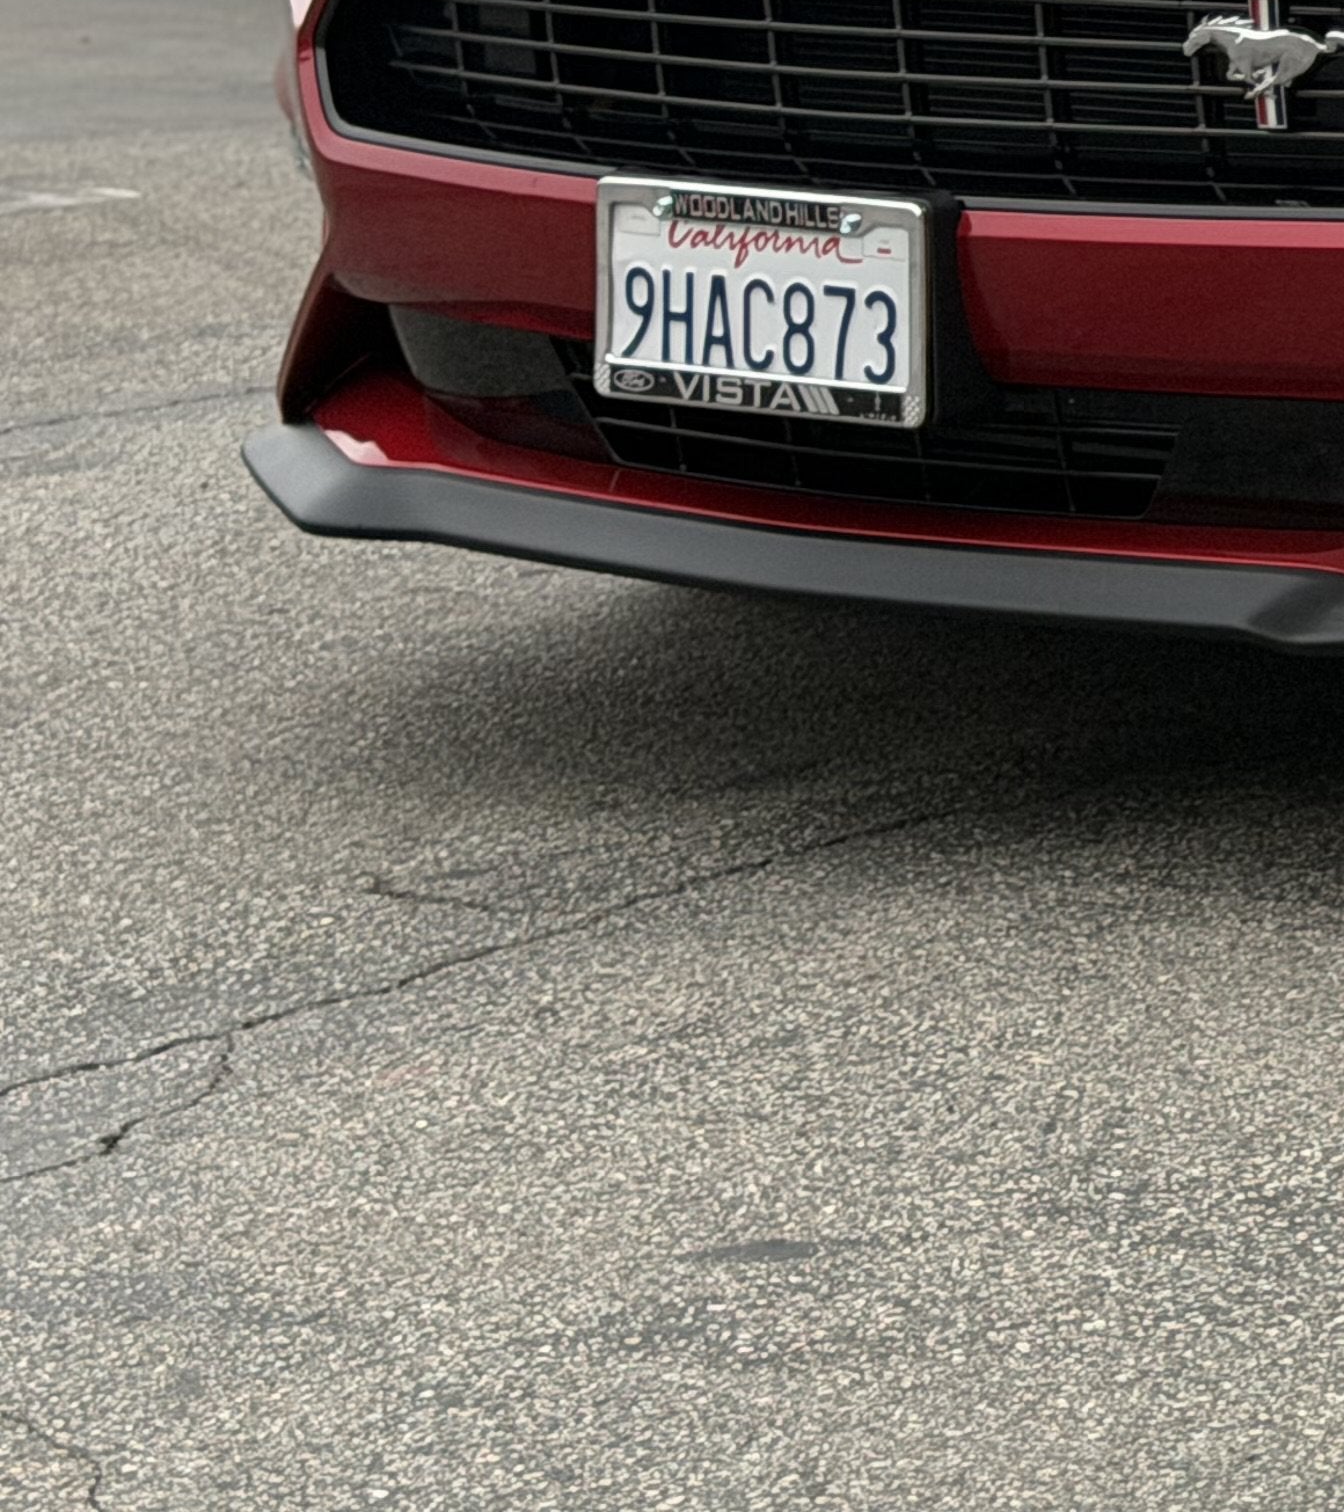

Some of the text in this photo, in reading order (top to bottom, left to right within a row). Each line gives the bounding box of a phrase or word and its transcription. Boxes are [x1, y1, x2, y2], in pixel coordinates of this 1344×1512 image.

[673, 193, 842, 230] WOODLAND HILLS
[668, 219, 864, 269] California
[620, 266, 897, 384] 9HAC873
[673, 370, 801, 412] VISTA
